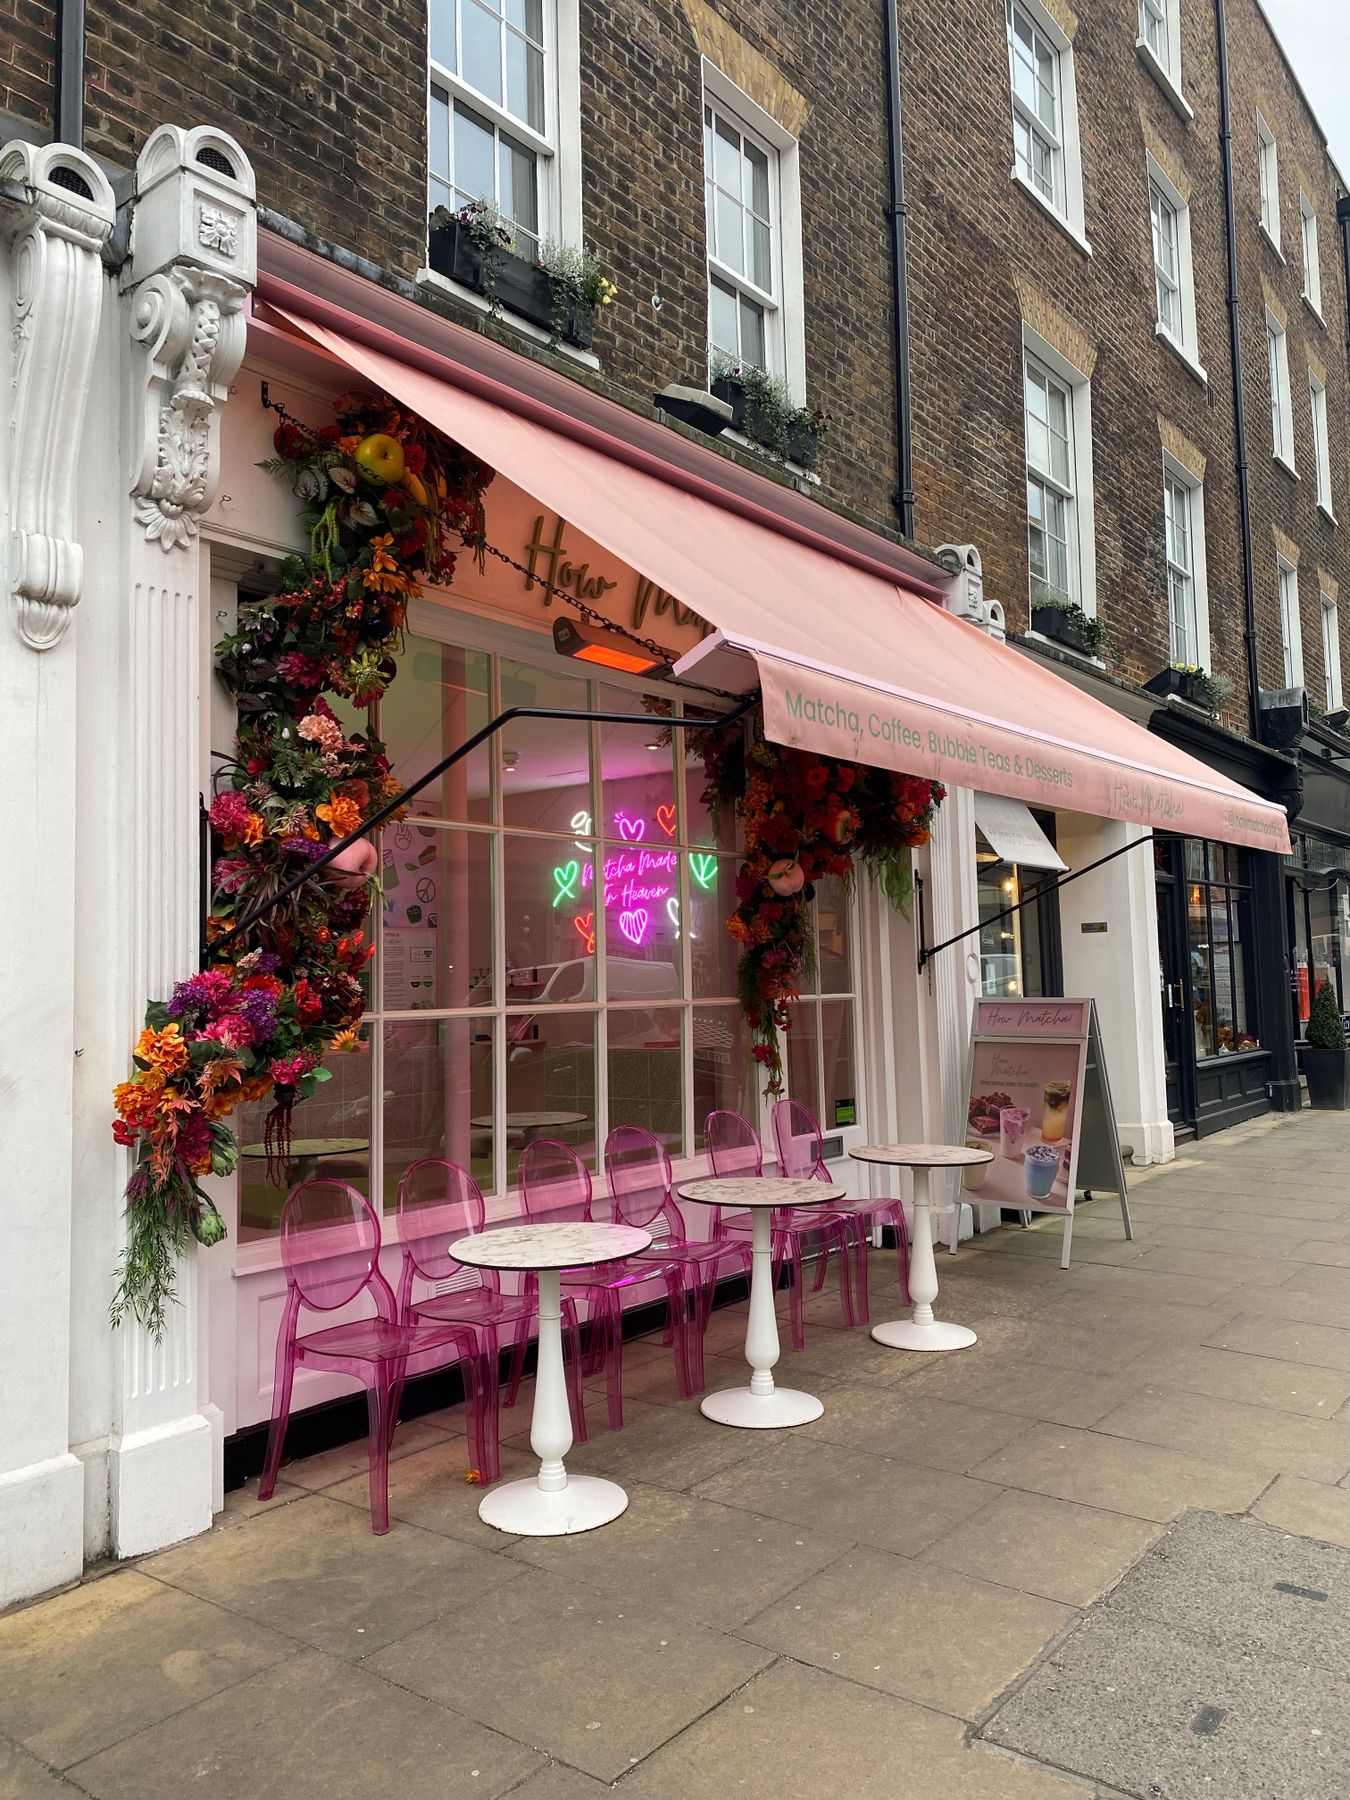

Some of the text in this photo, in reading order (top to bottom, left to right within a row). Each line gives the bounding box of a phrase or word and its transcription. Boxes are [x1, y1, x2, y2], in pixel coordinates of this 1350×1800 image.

[525, 515, 617, 607] How
[784, 689, 1073, 788] Matcha, Coffee, Bubble Teas & Desserts
[582, 850, 678, 887] Mtcha Made
[621, 879, 669, 908] Heaven
[987, 1007, 1073, 1027] How Matcha
